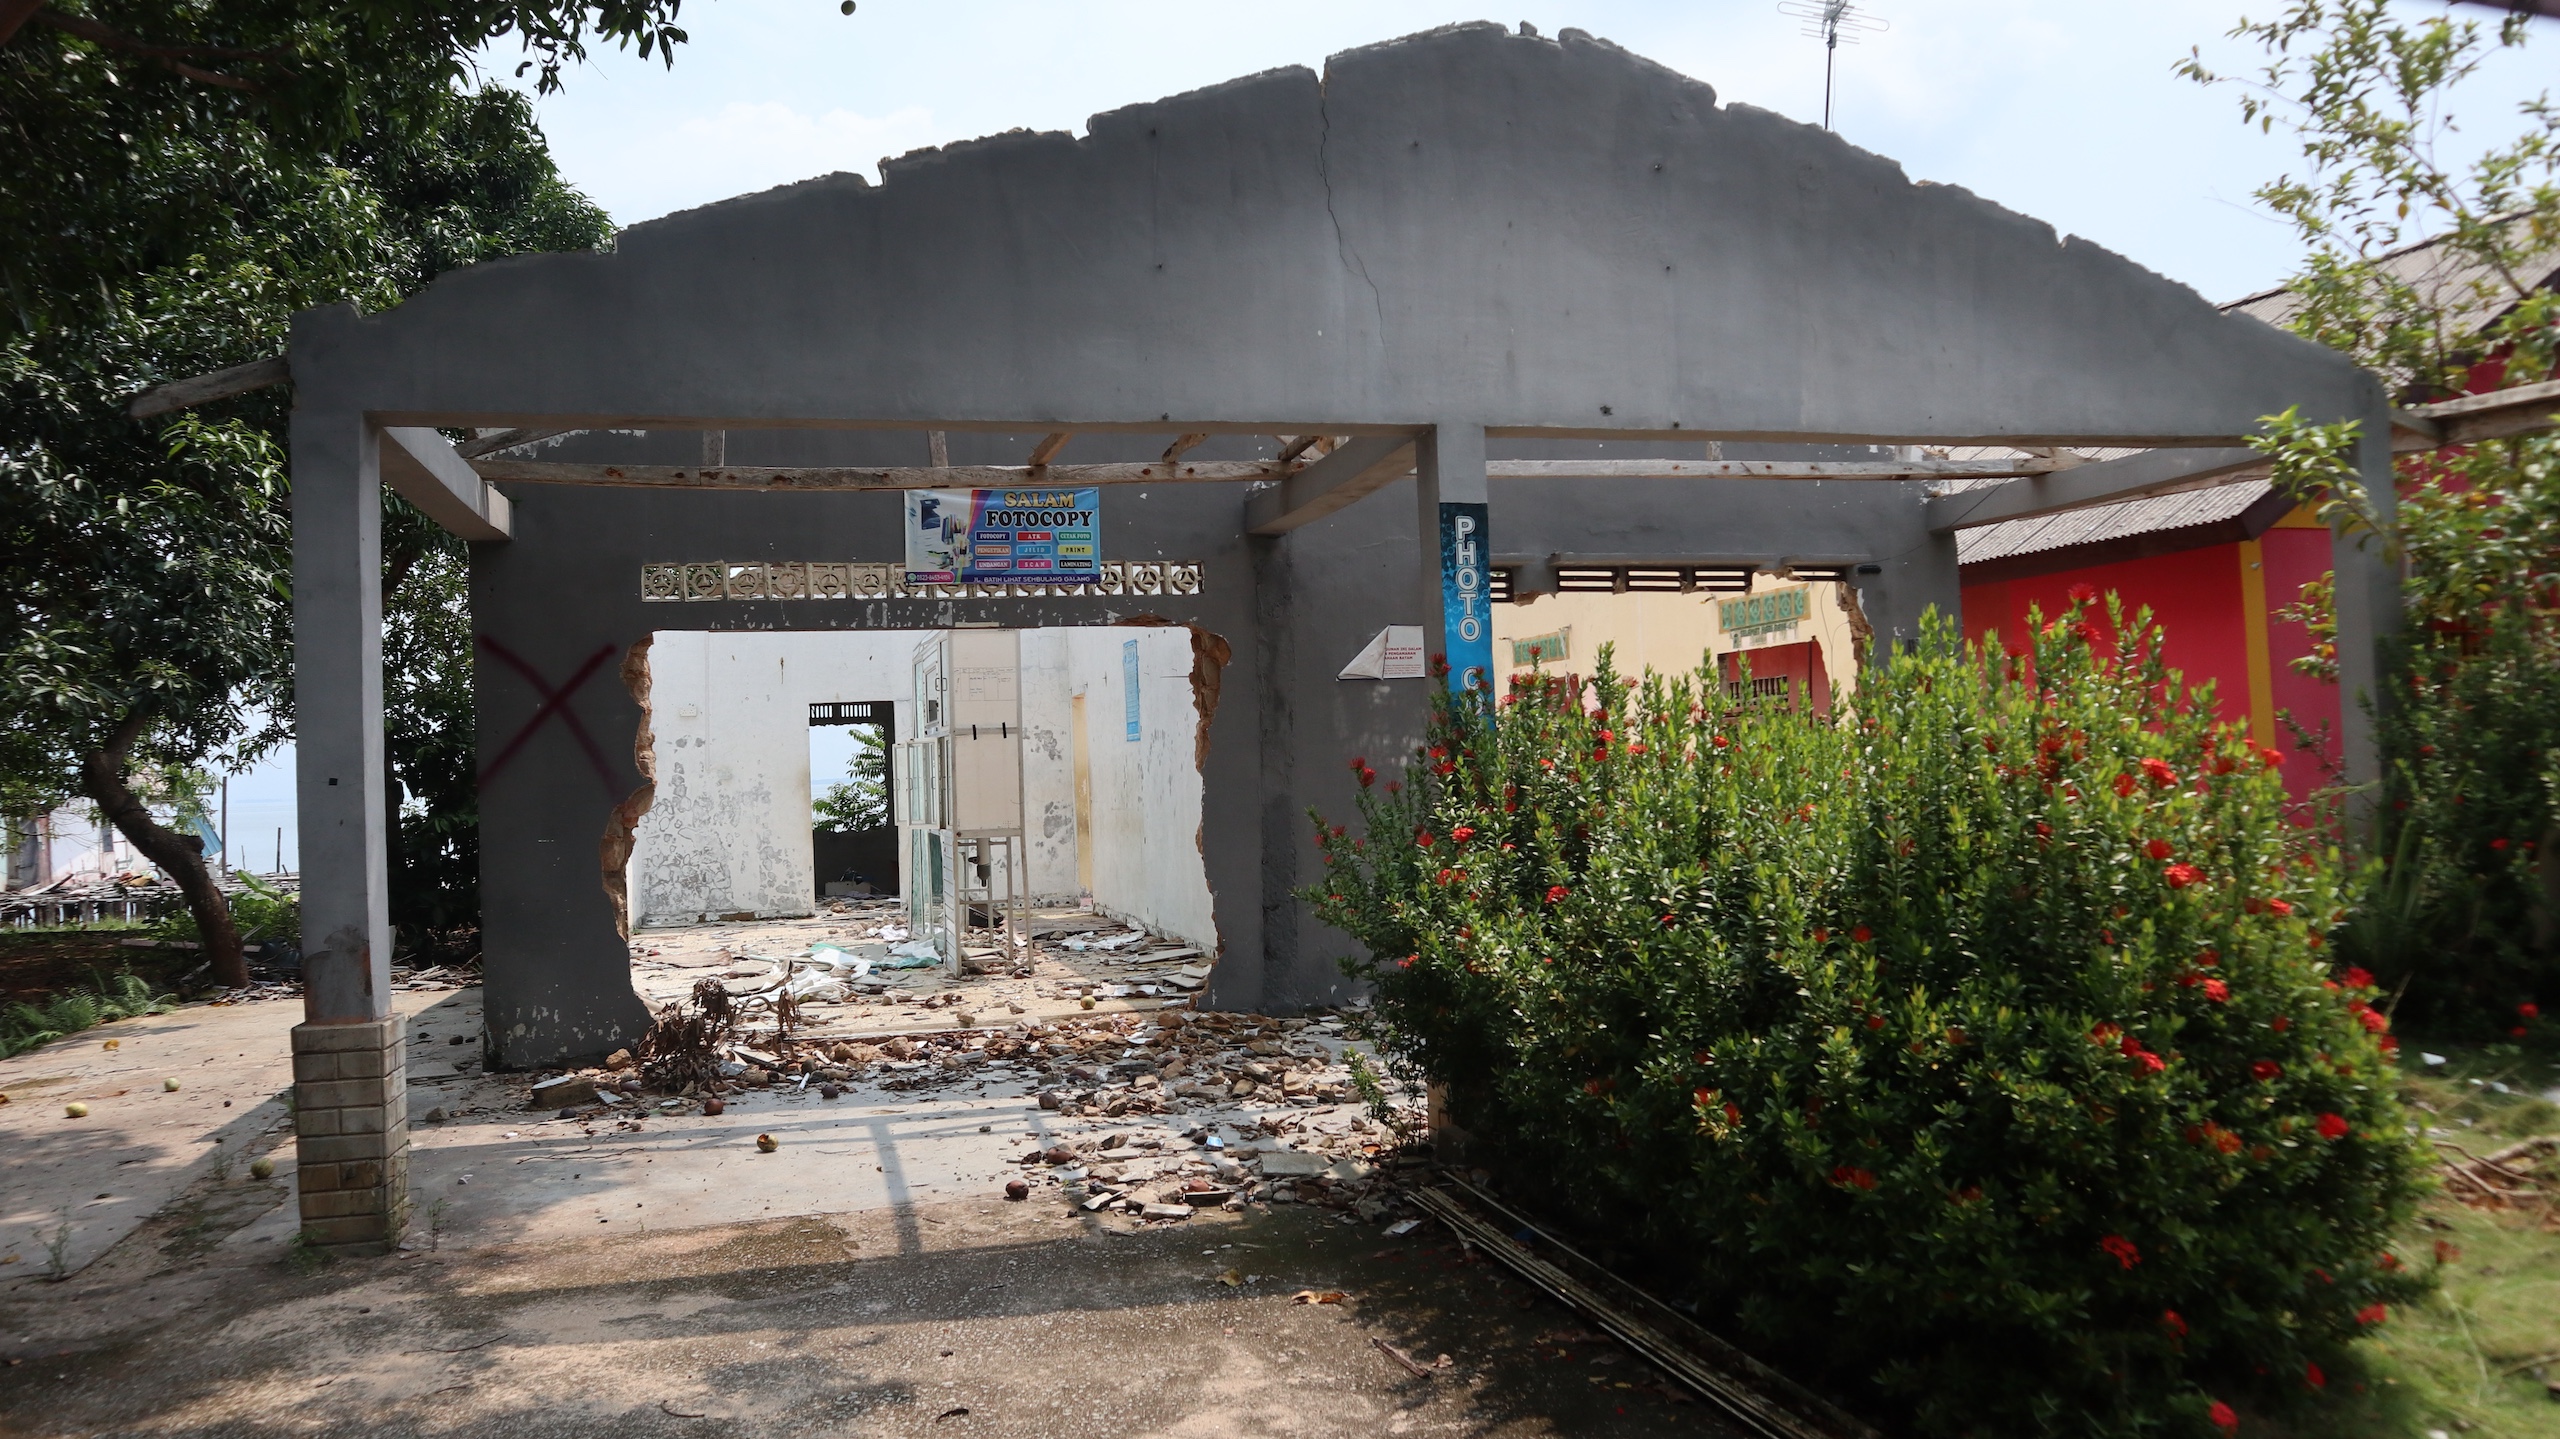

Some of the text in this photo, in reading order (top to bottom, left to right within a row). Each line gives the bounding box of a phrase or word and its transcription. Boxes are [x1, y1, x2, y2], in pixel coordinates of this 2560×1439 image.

[1004, 492, 1075, 508] SALAM
[985, 510, 1093, 527] FOTOCOPY
[1454, 515, 1482, 642] PHOTO
